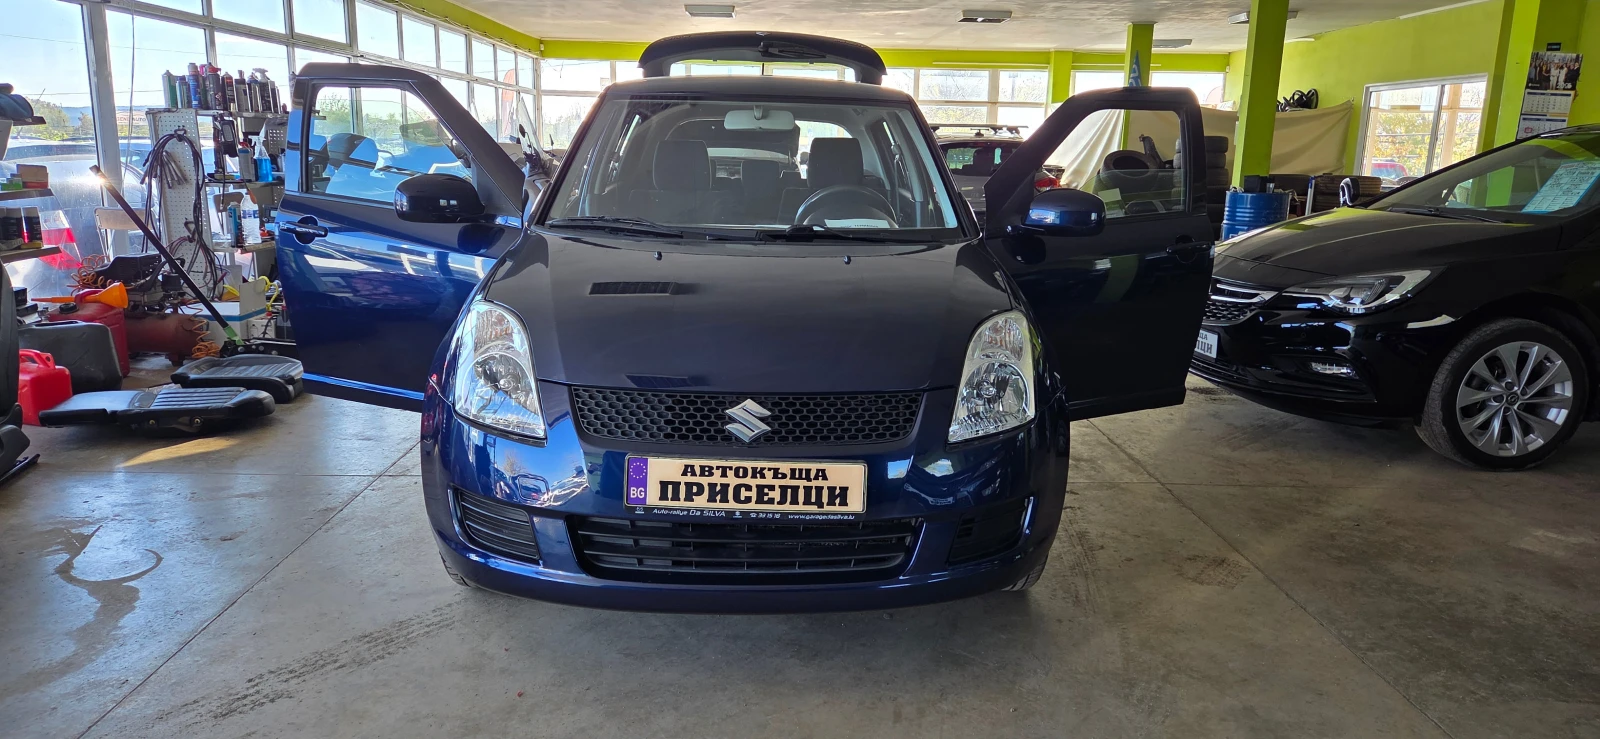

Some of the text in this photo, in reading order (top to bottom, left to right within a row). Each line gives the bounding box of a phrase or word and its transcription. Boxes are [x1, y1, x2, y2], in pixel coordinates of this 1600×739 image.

[680, 464, 829, 481] АВТОКЪЩА
[630, 486, 645, 499] BG
[658, 480, 850, 509] ПРИСЕЛЦИ
[652, 508, 688, 516] Auto-rallye
